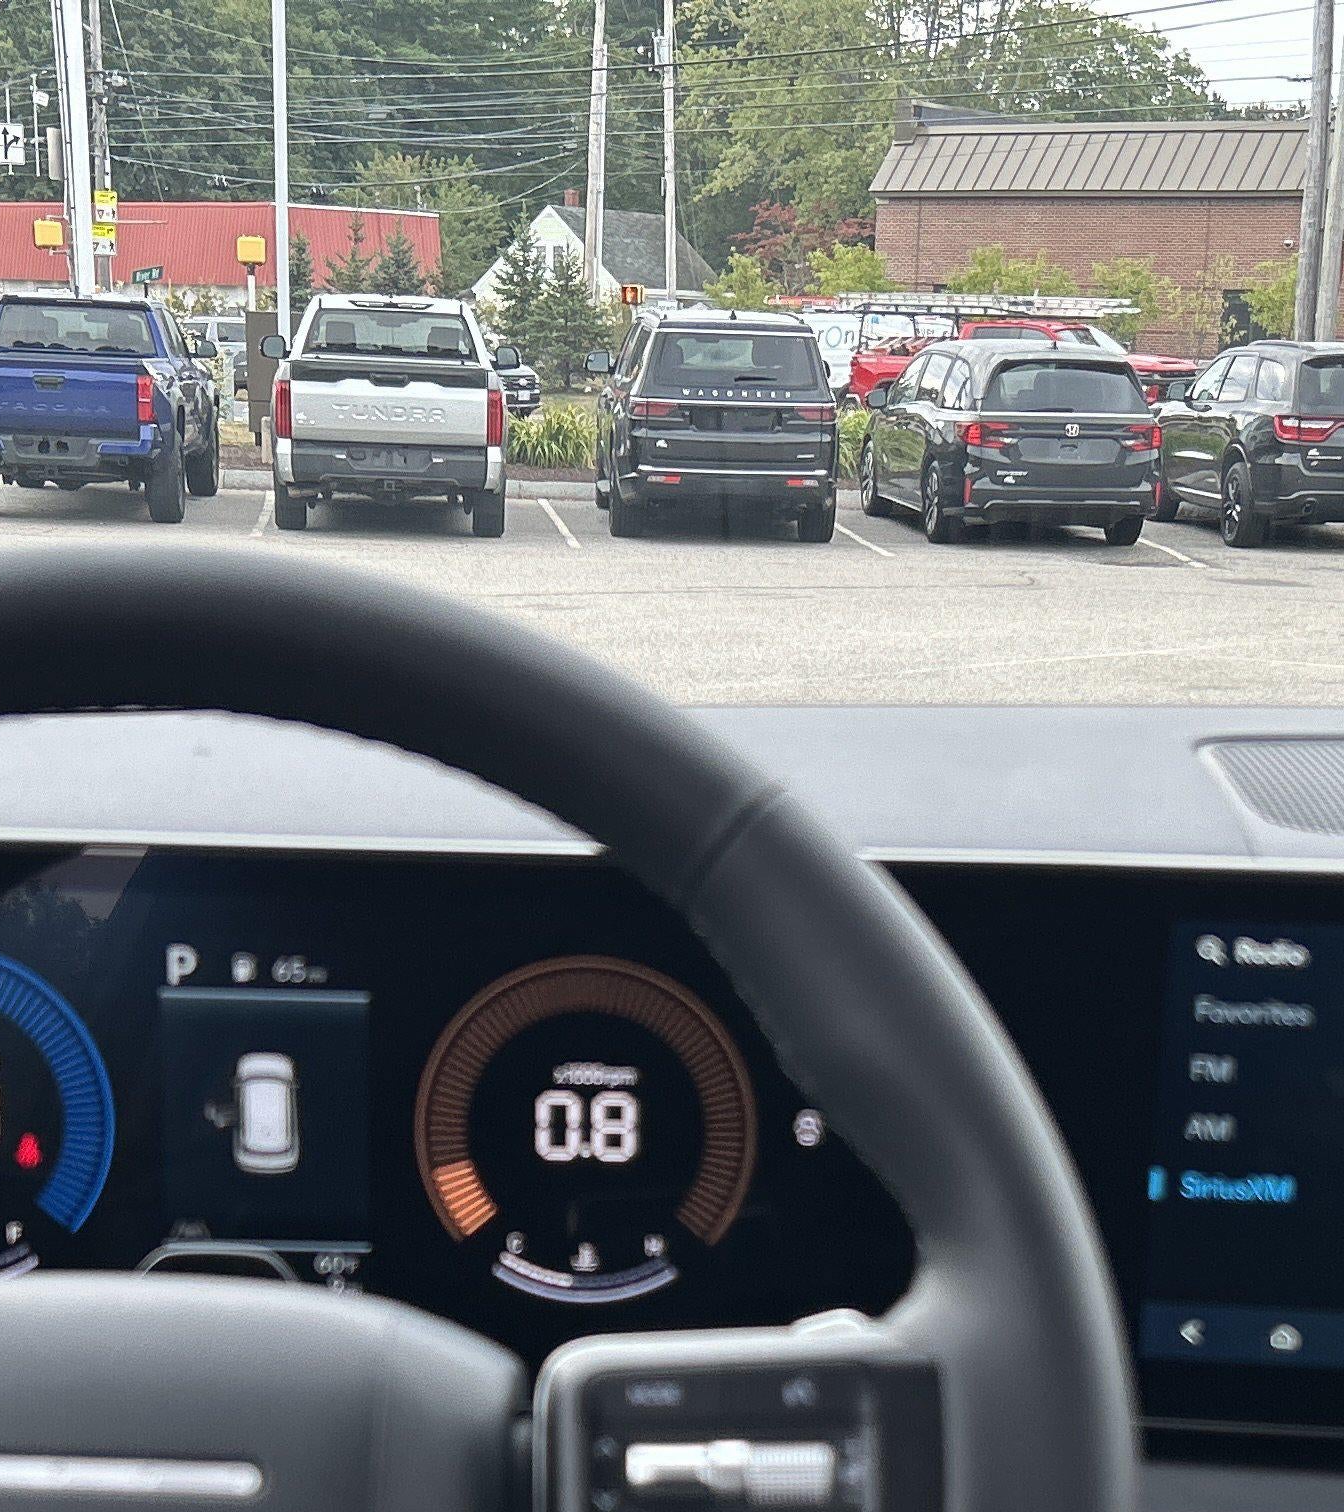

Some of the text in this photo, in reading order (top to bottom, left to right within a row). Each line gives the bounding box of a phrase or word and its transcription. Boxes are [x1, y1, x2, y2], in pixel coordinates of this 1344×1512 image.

[331, 401, 446, 424] TUNDRA
[165, 942, 199, 986] P
[1193, 994, 1315, 1027] Favorites
[1189, 1053, 1238, 1083] FM
[534, 1089, 639, 1162] 0.8
[1184, 1112, 1237, 1142] AM
[1179, 1170, 1297, 1203] SiriusXM
